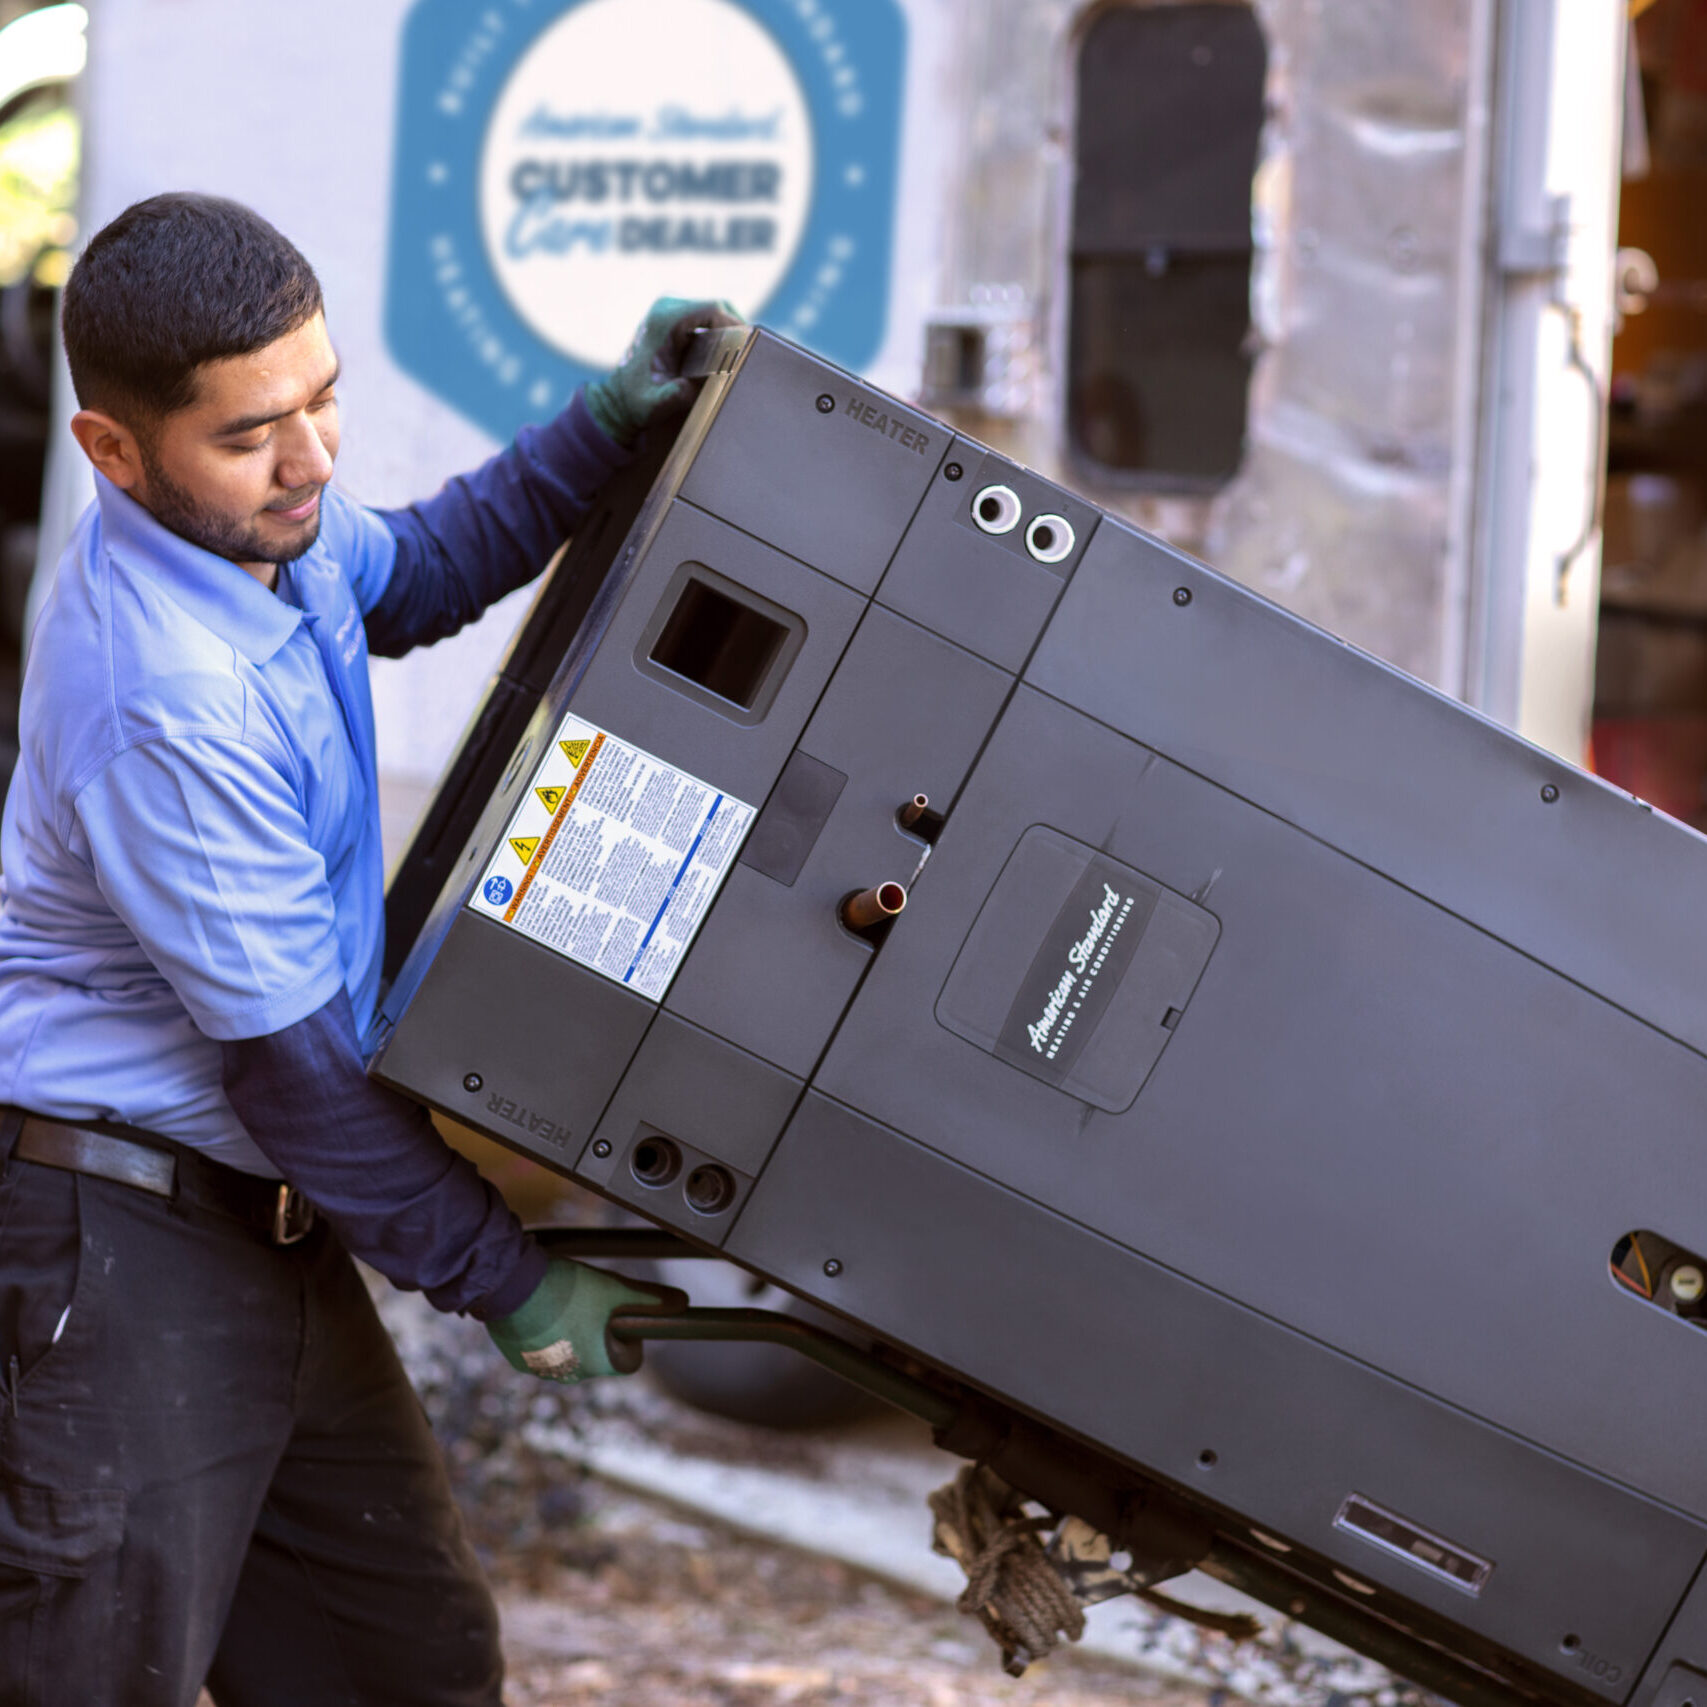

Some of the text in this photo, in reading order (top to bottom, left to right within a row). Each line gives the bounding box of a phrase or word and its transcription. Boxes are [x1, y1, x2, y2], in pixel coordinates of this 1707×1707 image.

[509, 160, 783, 205] CUSTOMER
[504, 186, 778, 264] Care DEALER
[845, 397, 930, 455] HEATER
[510, 734, 604, 910] WARNING AVERTISSEMENT ADVERTENCIA
[1027, 882, 1120, 1053] American Standard
[1046, 897, 1135, 1060] HEATING & AIR CONDITIONING
[486, 1092, 573, 1151] HEATER
[1578, 1649, 1623, 1686] COIL
